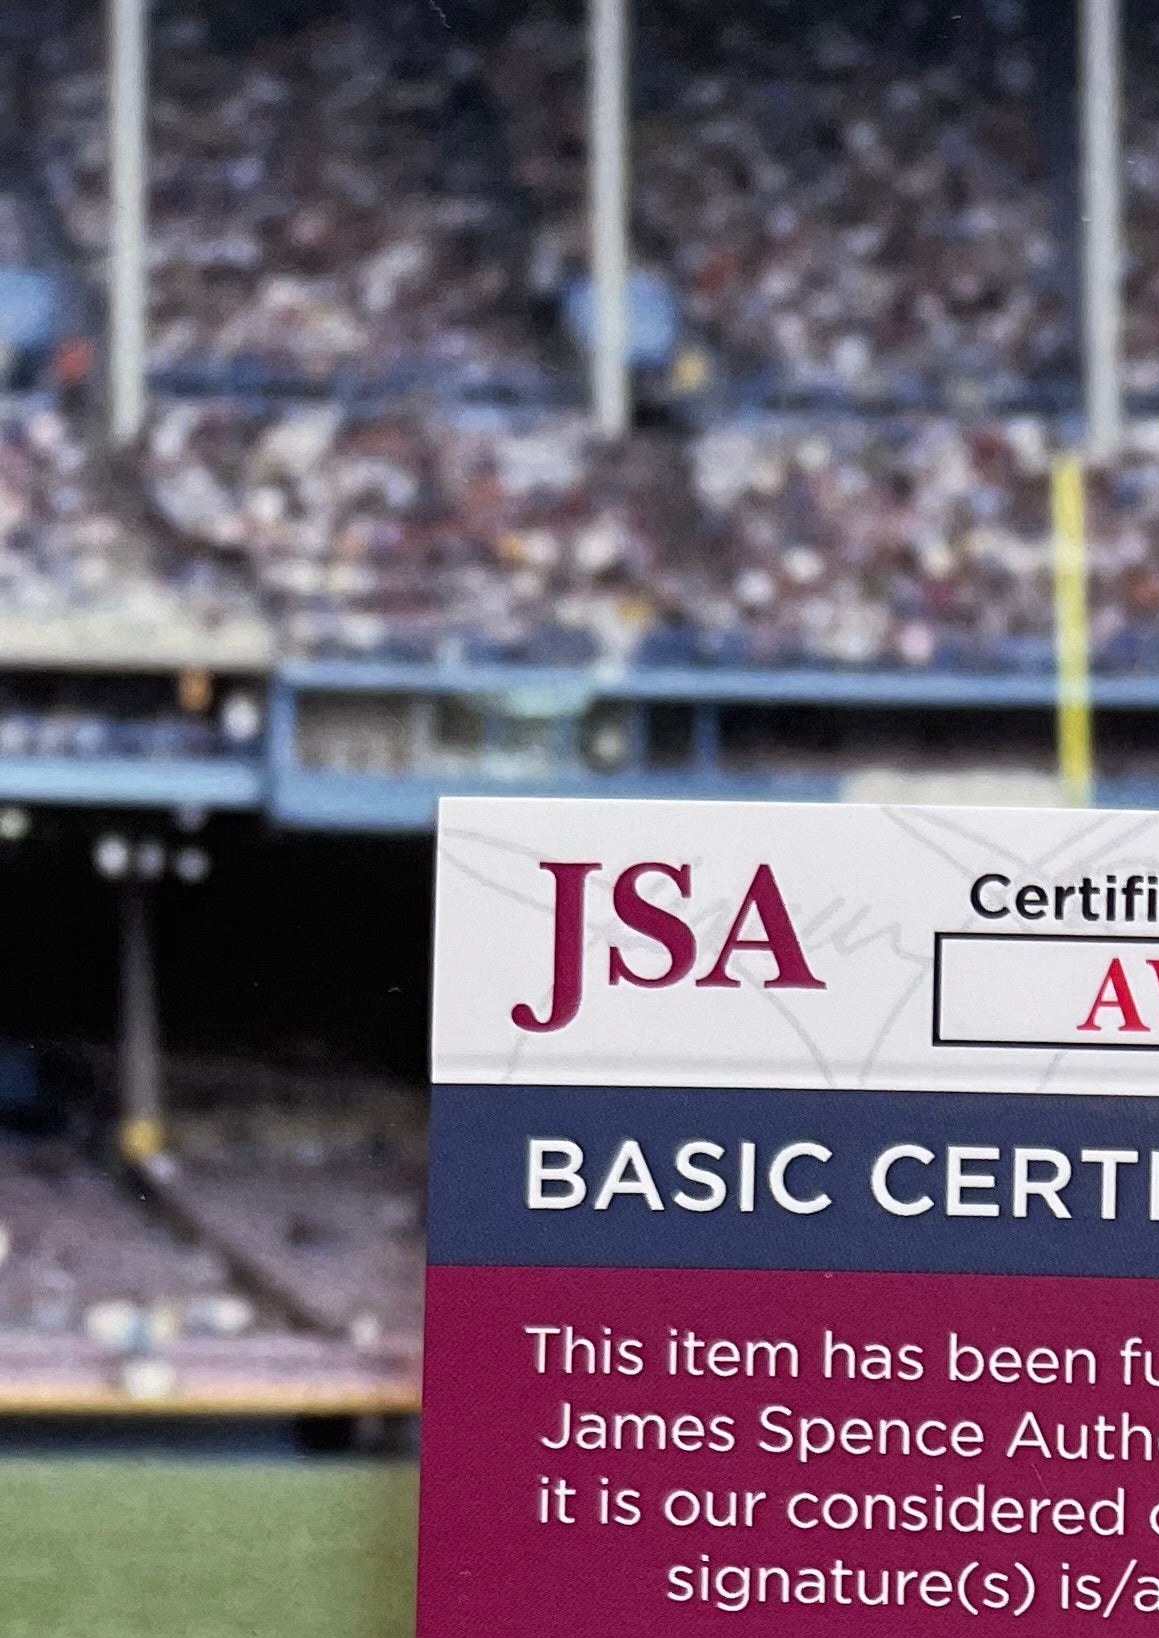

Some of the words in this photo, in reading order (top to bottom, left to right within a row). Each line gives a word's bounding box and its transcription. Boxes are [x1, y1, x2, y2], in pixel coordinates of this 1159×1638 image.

[511, 861, 826, 1033] JSA
[526, 1138, 834, 1215] BASIC
[524, 1325, 644, 1375] This
[668, 1327, 799, 1378] item
[824, 1330, 924, 1381] has
[949, 1332, 1096, 1385] been
[541, 1402, 735, 1452] James
[758, 1405, 984, 1463] Spence
[539, 1476, 576, 1524] it
[600, 1477, 641, 1526] is
[663, 1489, 767, 1527] our
[786, 1483, 1125, 1536] considered
[667, 1554, 1036, 1617] signature(s)
